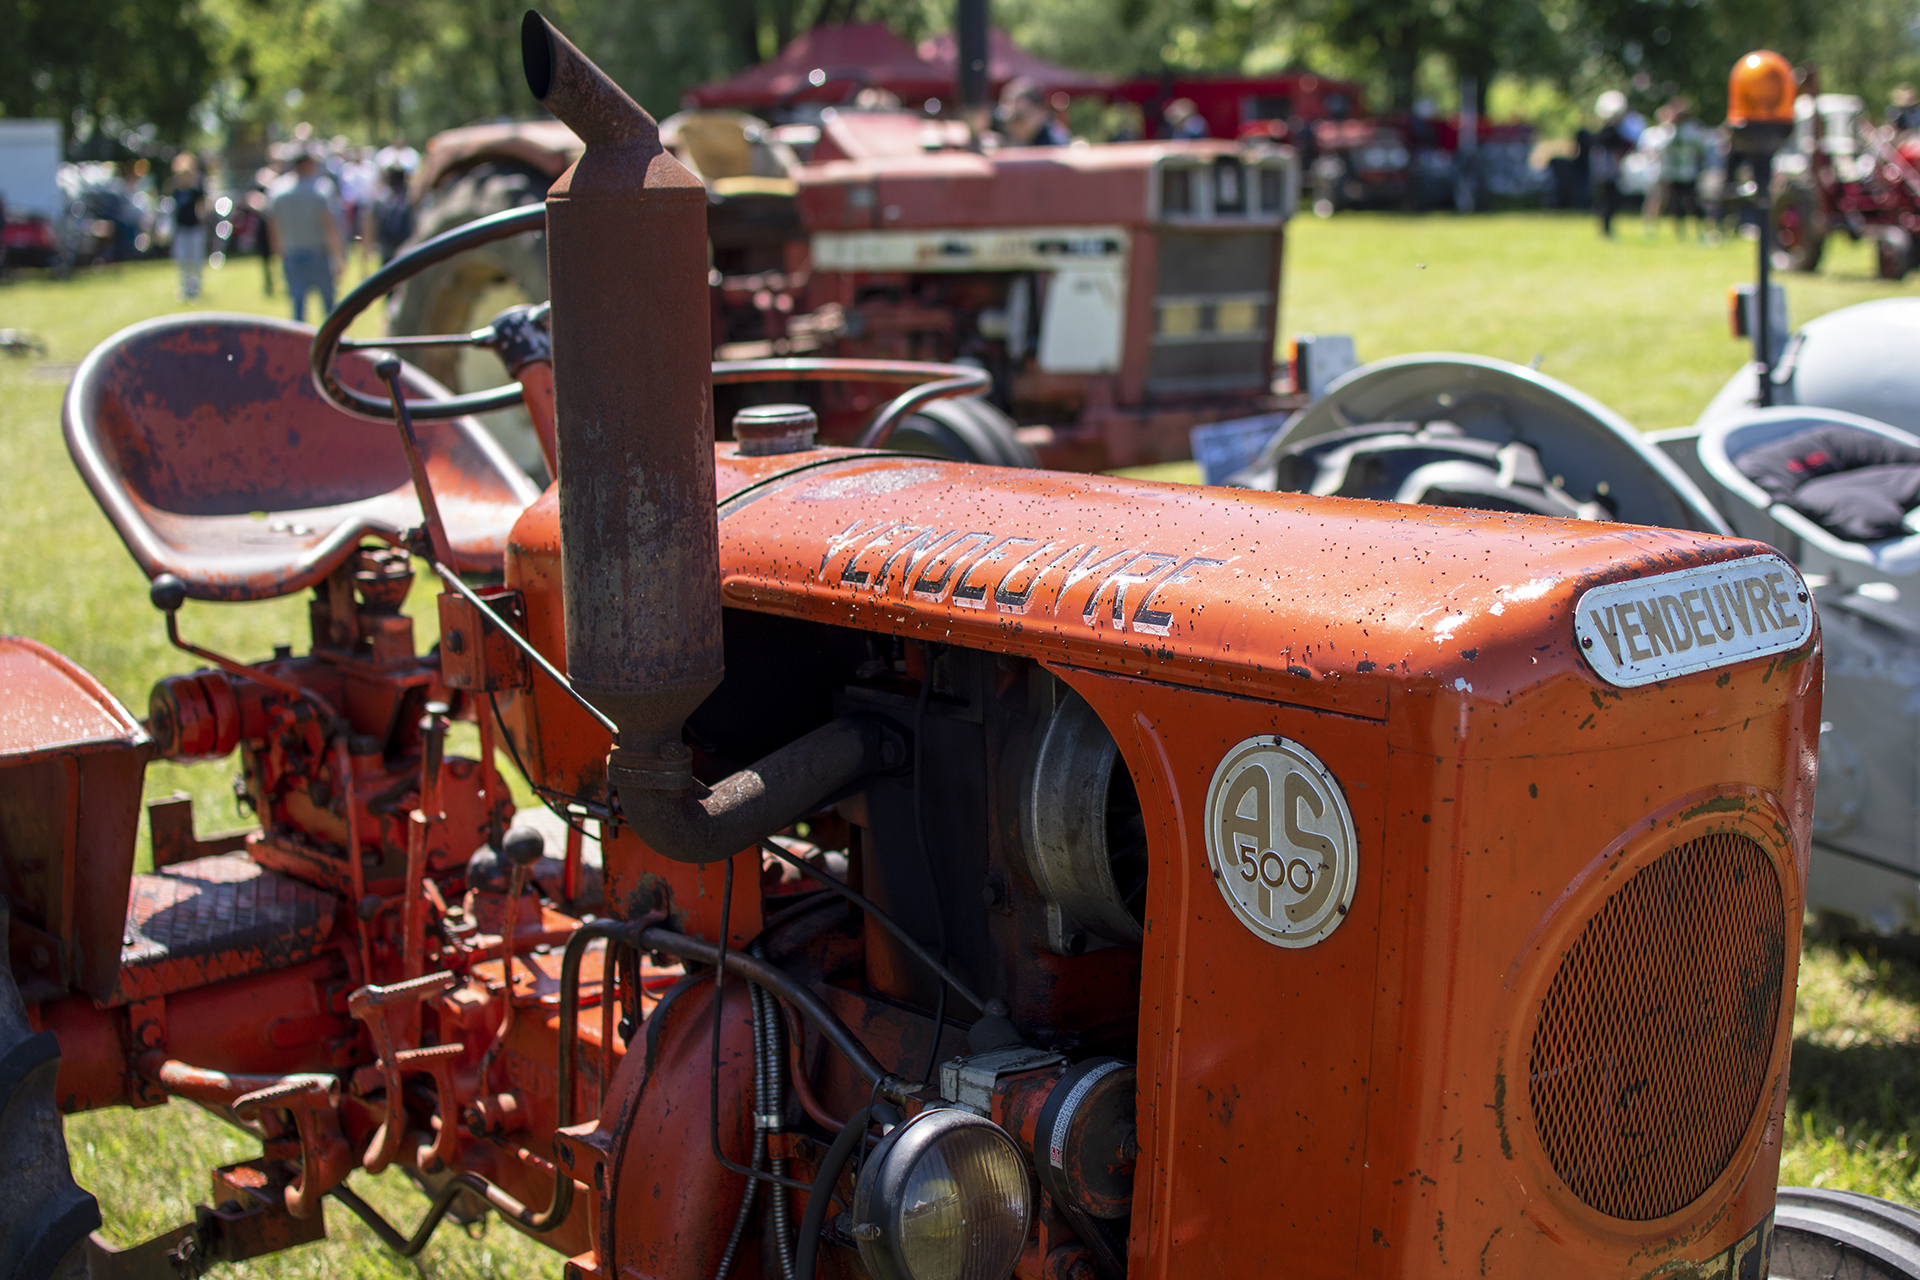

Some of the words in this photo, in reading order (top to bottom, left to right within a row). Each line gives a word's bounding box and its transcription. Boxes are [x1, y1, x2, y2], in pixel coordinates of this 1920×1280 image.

[818, 519, 1228, 637] VENDEUVRE
[1588, 571, 1801, 668] VENDEUVRE
[1240, 843, 1315, 895] 500
